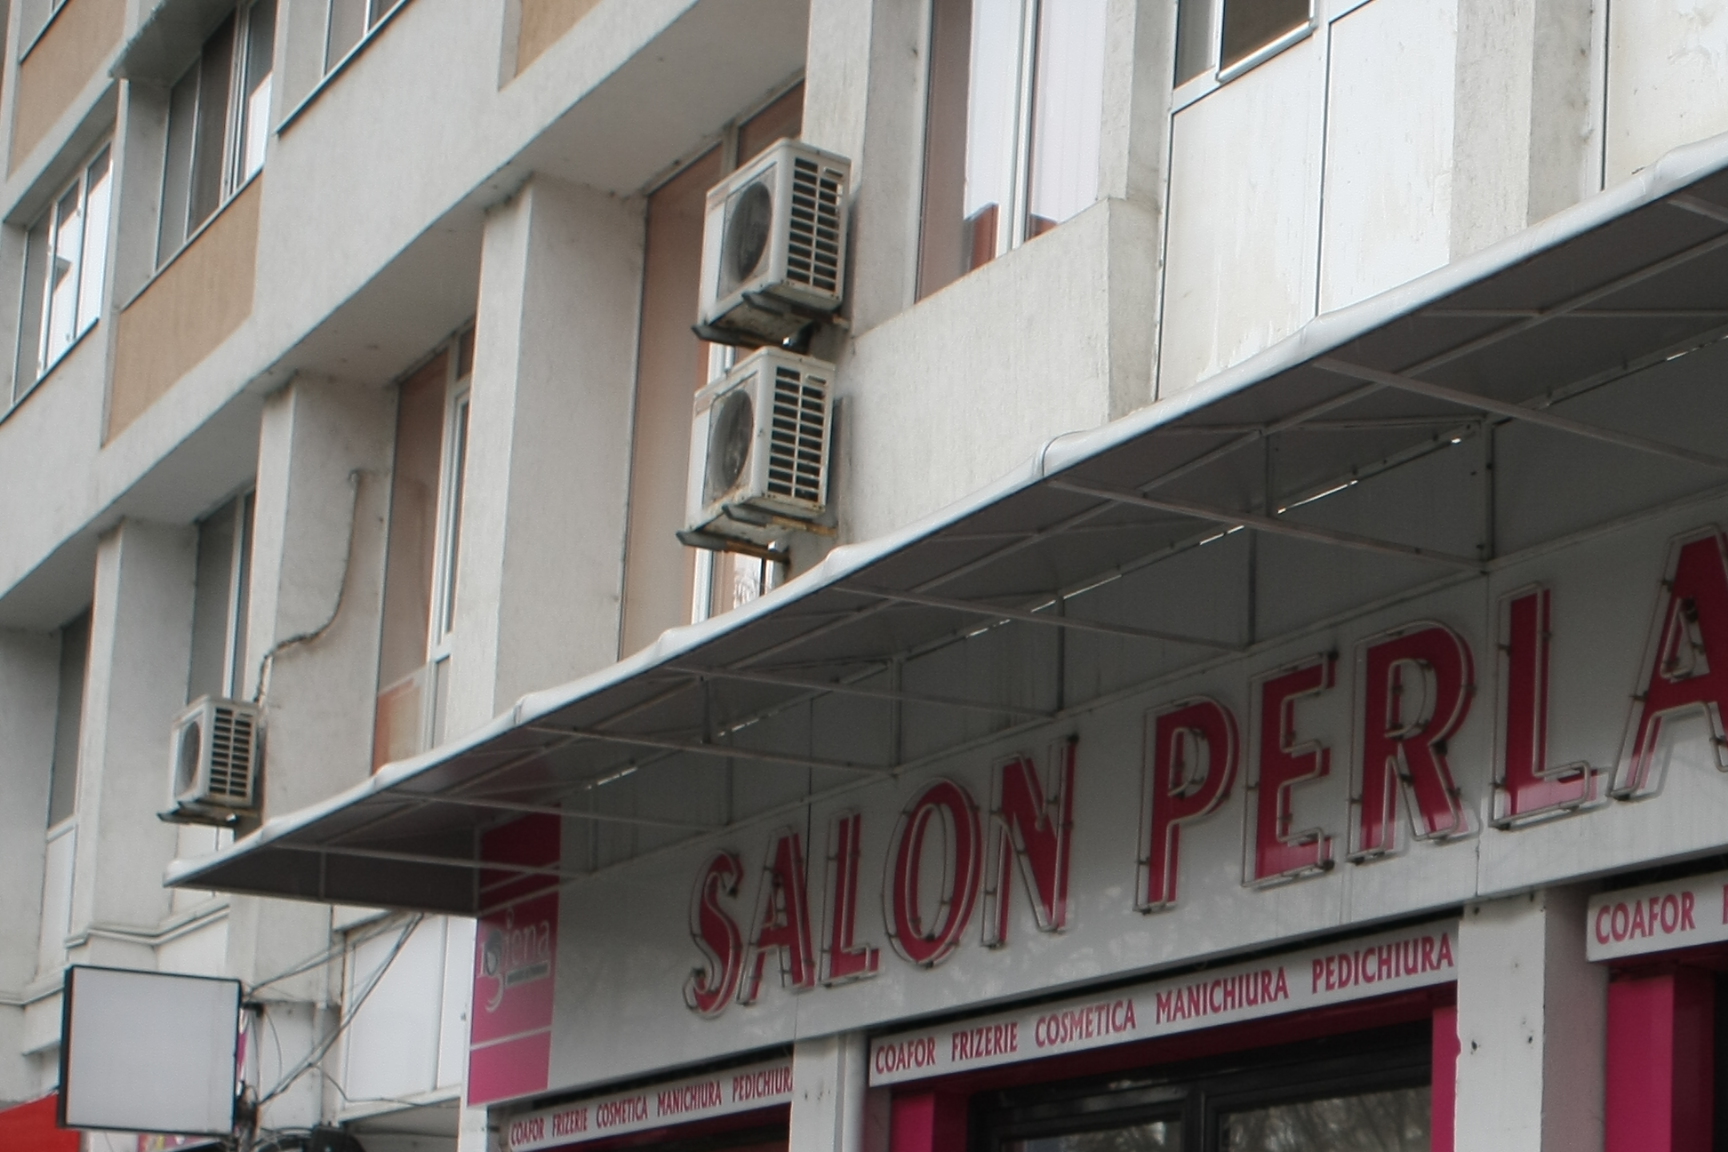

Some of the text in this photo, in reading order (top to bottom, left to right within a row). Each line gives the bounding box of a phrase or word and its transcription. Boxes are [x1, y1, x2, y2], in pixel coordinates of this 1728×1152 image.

[682, 734, 1079, 1018] SALON
[1595, 891, 1695, 945] COAFOR
[875, 933, 1454, 1074] COAFOR FRIZERIE COSMETICA MANICHIURA PEDICHIURA
[511, 1117, 544, 1146] COAFOR
[552, 1108, 588, 1138] FRIZERIE
[596, 1096, 648, 1128] COSMETICA
[657, 1080, 722, 1117] MANICHIURA
